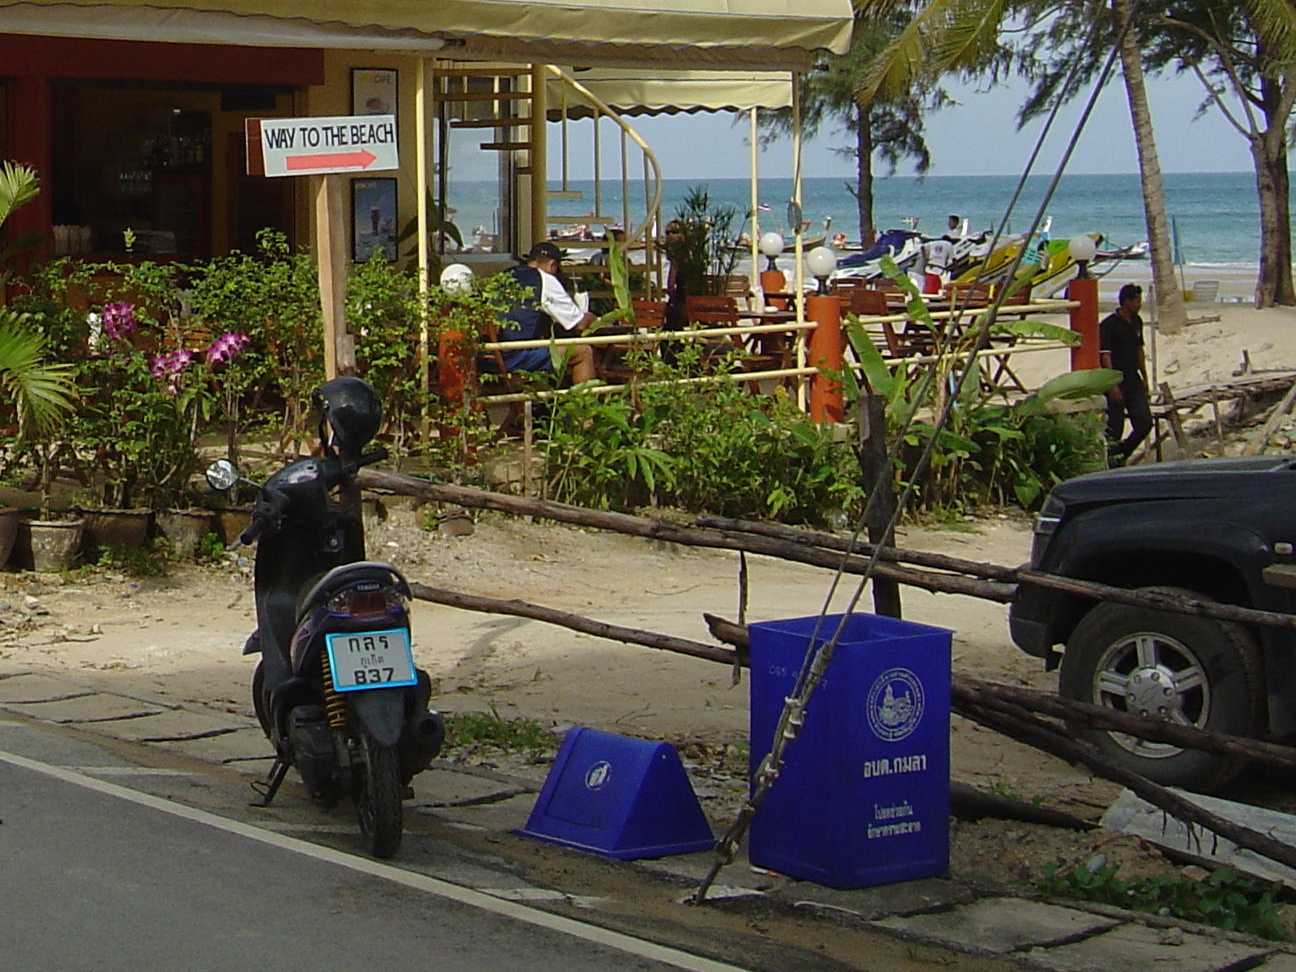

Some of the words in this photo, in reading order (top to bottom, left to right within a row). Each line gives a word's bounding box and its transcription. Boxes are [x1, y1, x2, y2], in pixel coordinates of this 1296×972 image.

[264, 127, 297, 150] WAY
[299, 127, 320, 148] TO
[321, 124, 349, 147] THE
[350, 122, 395, 146] BEACH
